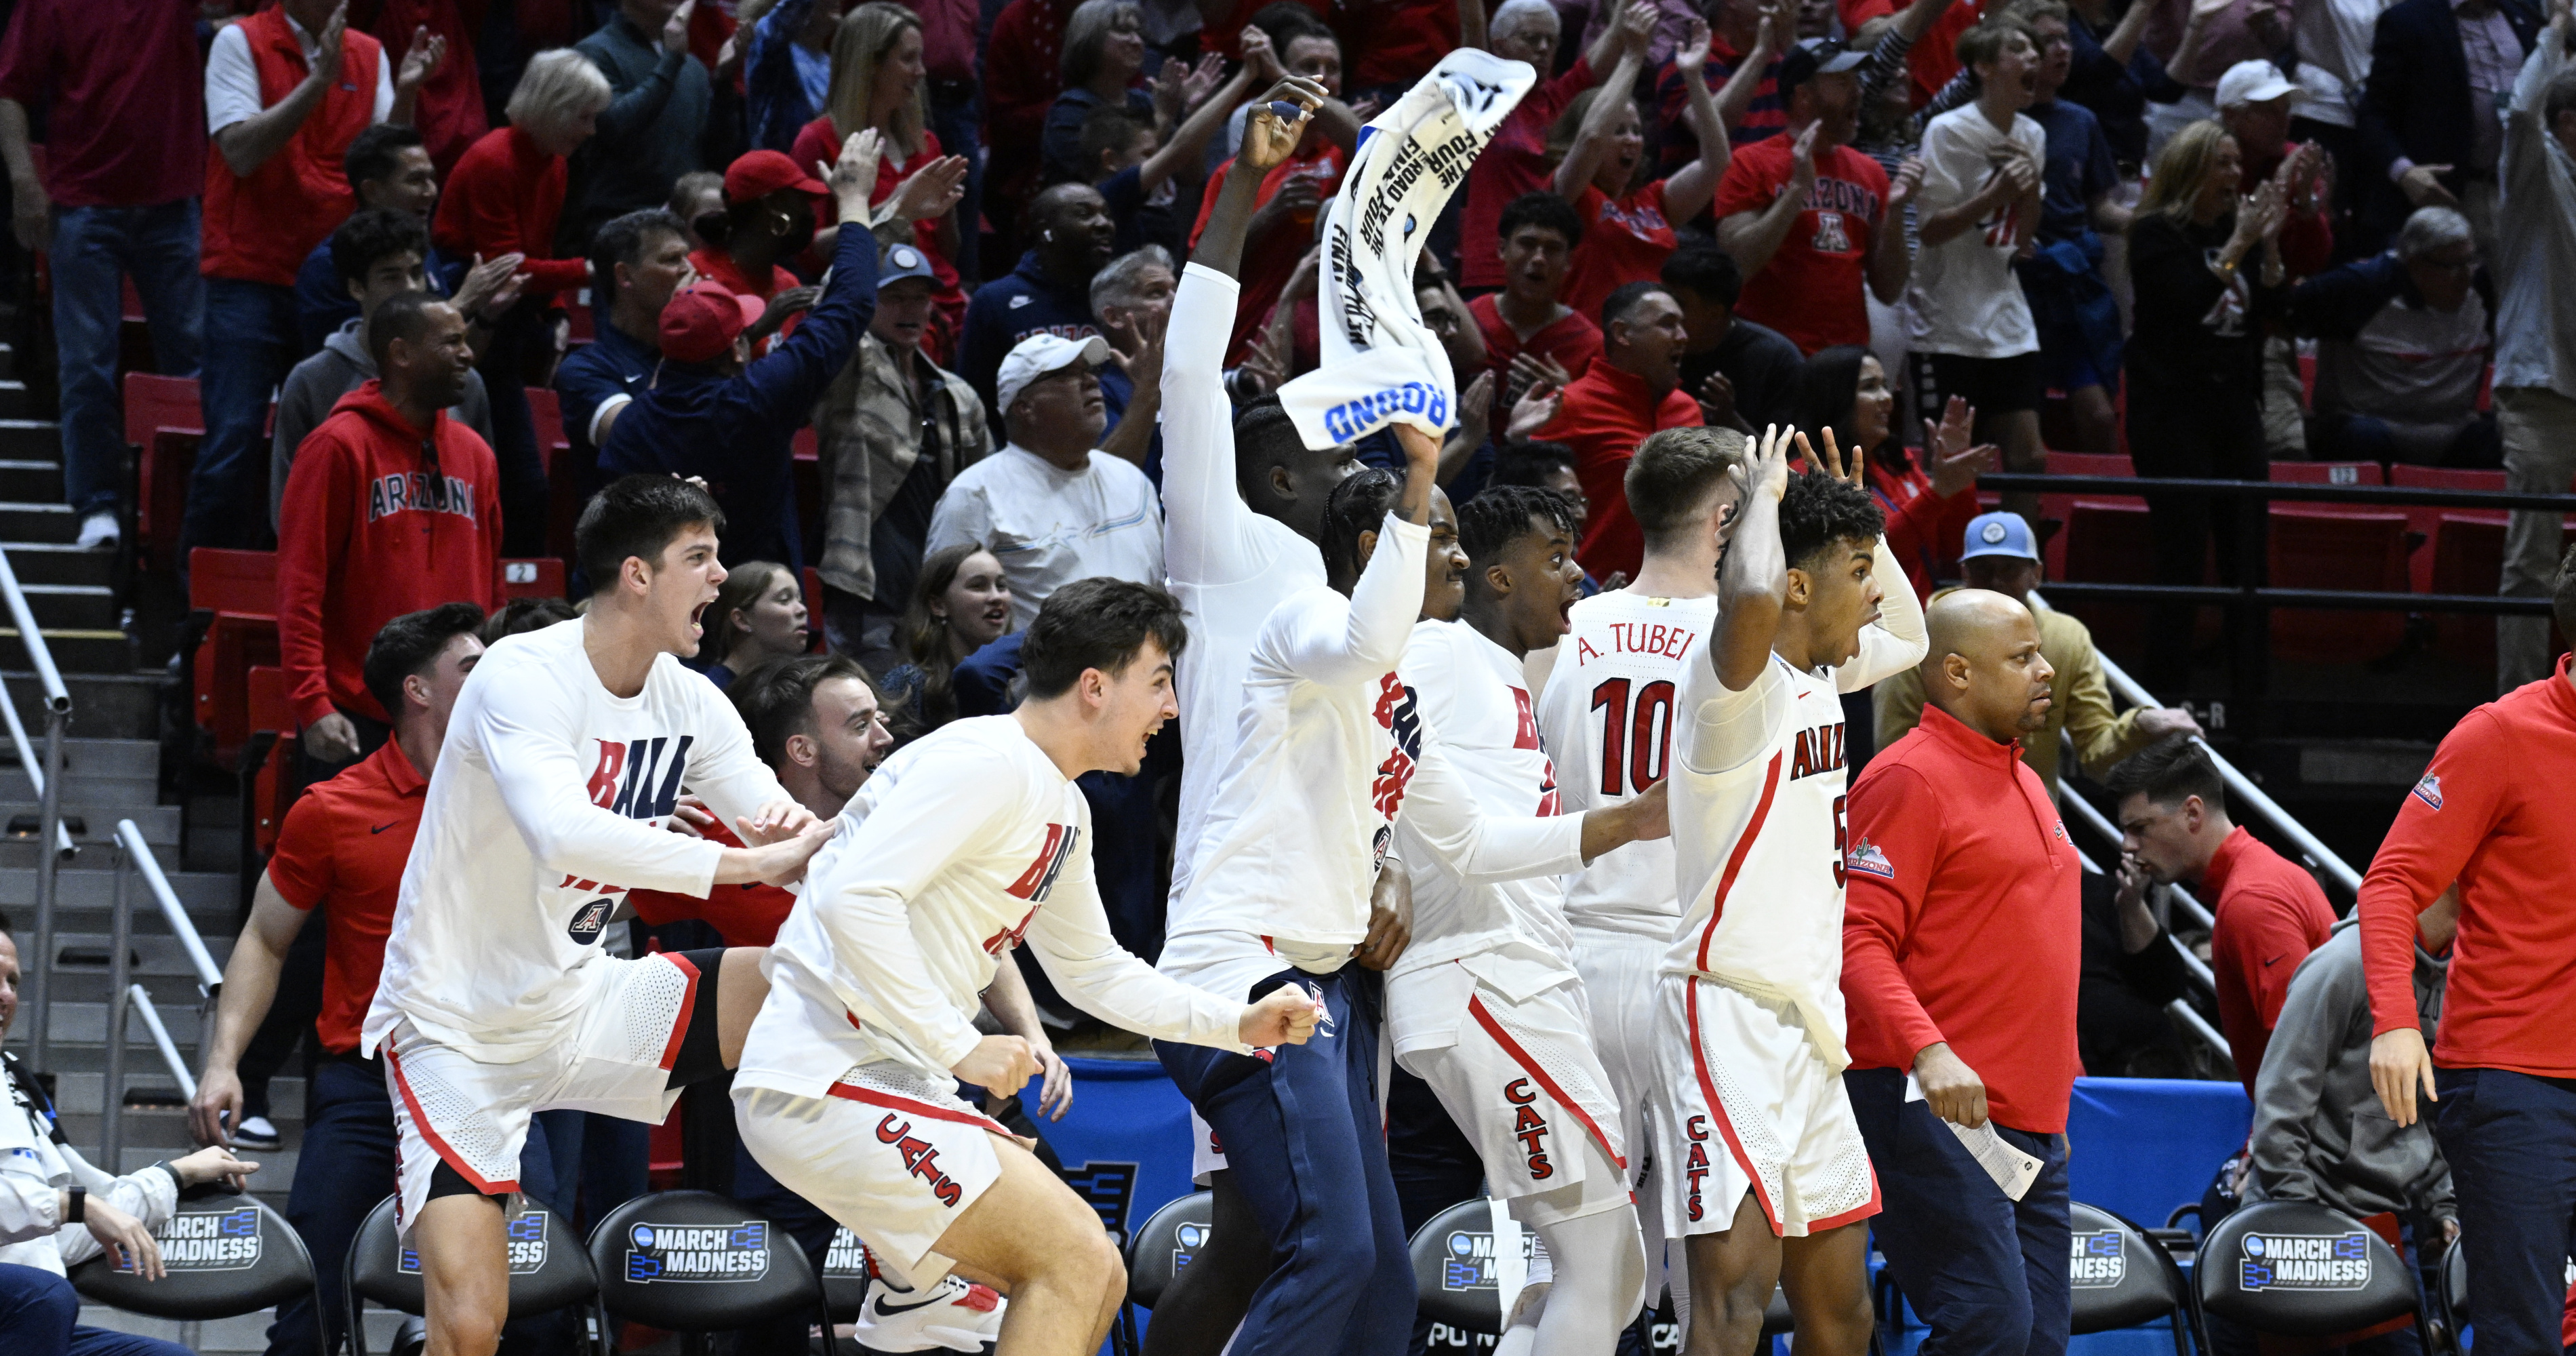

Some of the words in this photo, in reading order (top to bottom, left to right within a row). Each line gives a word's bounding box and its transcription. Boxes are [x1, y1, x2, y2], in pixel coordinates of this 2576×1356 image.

[1426, 128, 1478, 174] FOUR
[1387, 156, 1426, 203] ROAD
[1438, 164, 1469, 190] THE
[1324, 381, 1446, 444] ROUND
[517, 565, 527, 581] 2
[1578, 637, 1605, 666] A.
[1591, 677, 1675, 797] 10
[1790, 721, 1848, 782] ARIZ
[586, 735, 694, 820] BALL
[1833, 794, 1848, 890] 5
[570, 904, 609, 933] A
[1504, 1077, 1554, 1180] CATS
[875, 1113, 962, 1208] CATS
[1687, 1115, 1710, 1222] CATS
[157, 1236, 258, 1262] MADNESS
[655, 1229, 727, 1250] MARCH
[666, 1250, 766, 1273] MADNESS
[2265, 1239, 2332, 1260] MARCH
[2276, 1260, 2368, 1281] MADNESS
